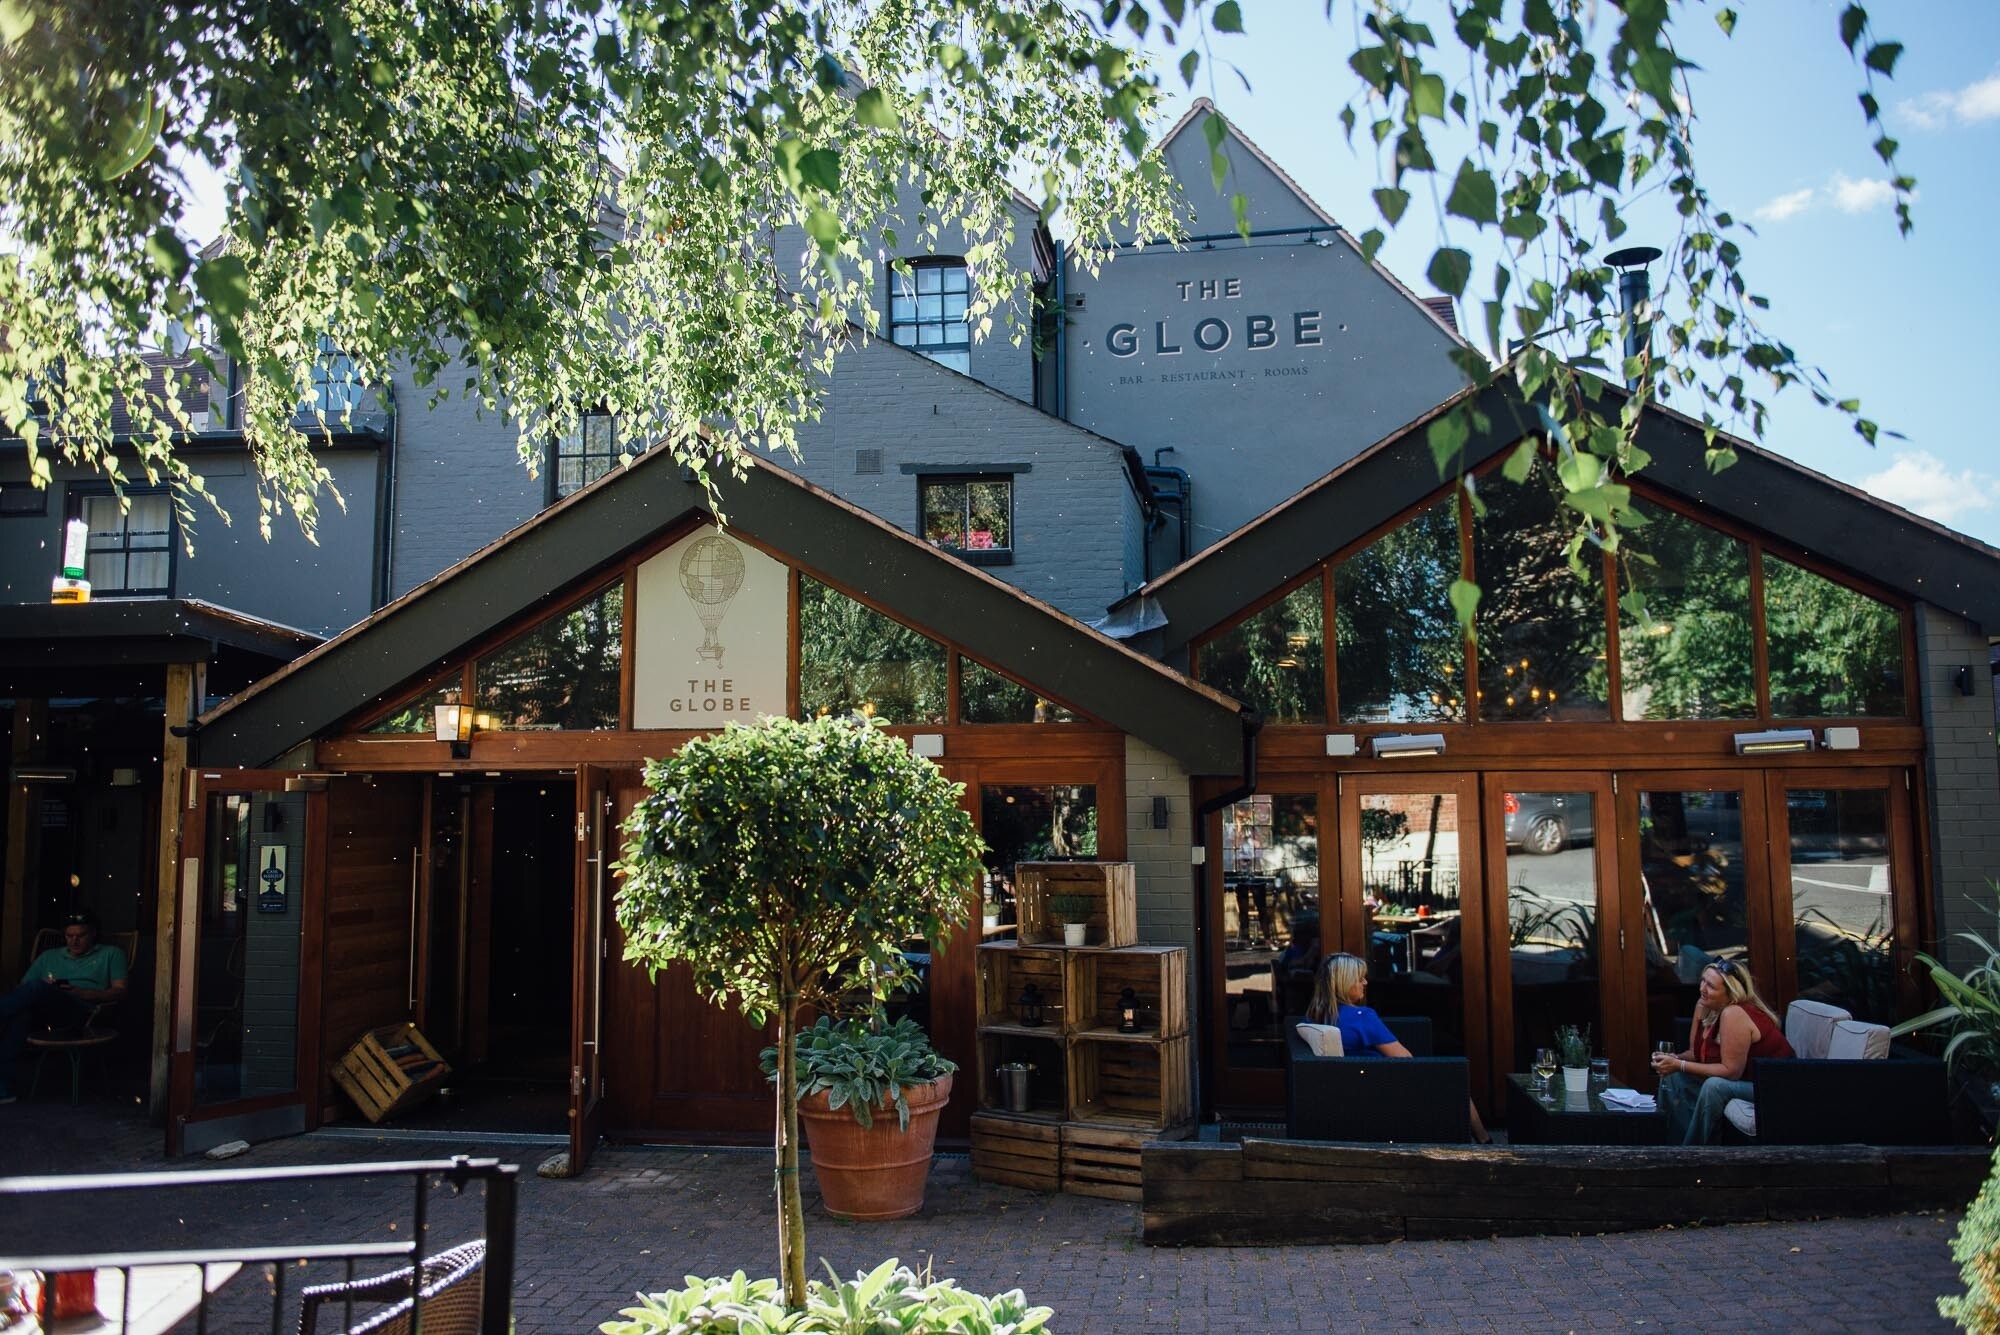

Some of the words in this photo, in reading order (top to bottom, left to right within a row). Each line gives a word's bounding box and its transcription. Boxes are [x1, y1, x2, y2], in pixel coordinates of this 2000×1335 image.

[1176, 278, 1242, 302] THE
[1105, 310, 1324, 359] GLOBE
[1119, 375, 1144, 385] BAR
[1161, 369, 1246, 384] RESTAURANT
[1264, 366, 1309, 378] ROOMS
[687, 679, 733, 693] THE
[669, 698, 751, 713] GLOBE
